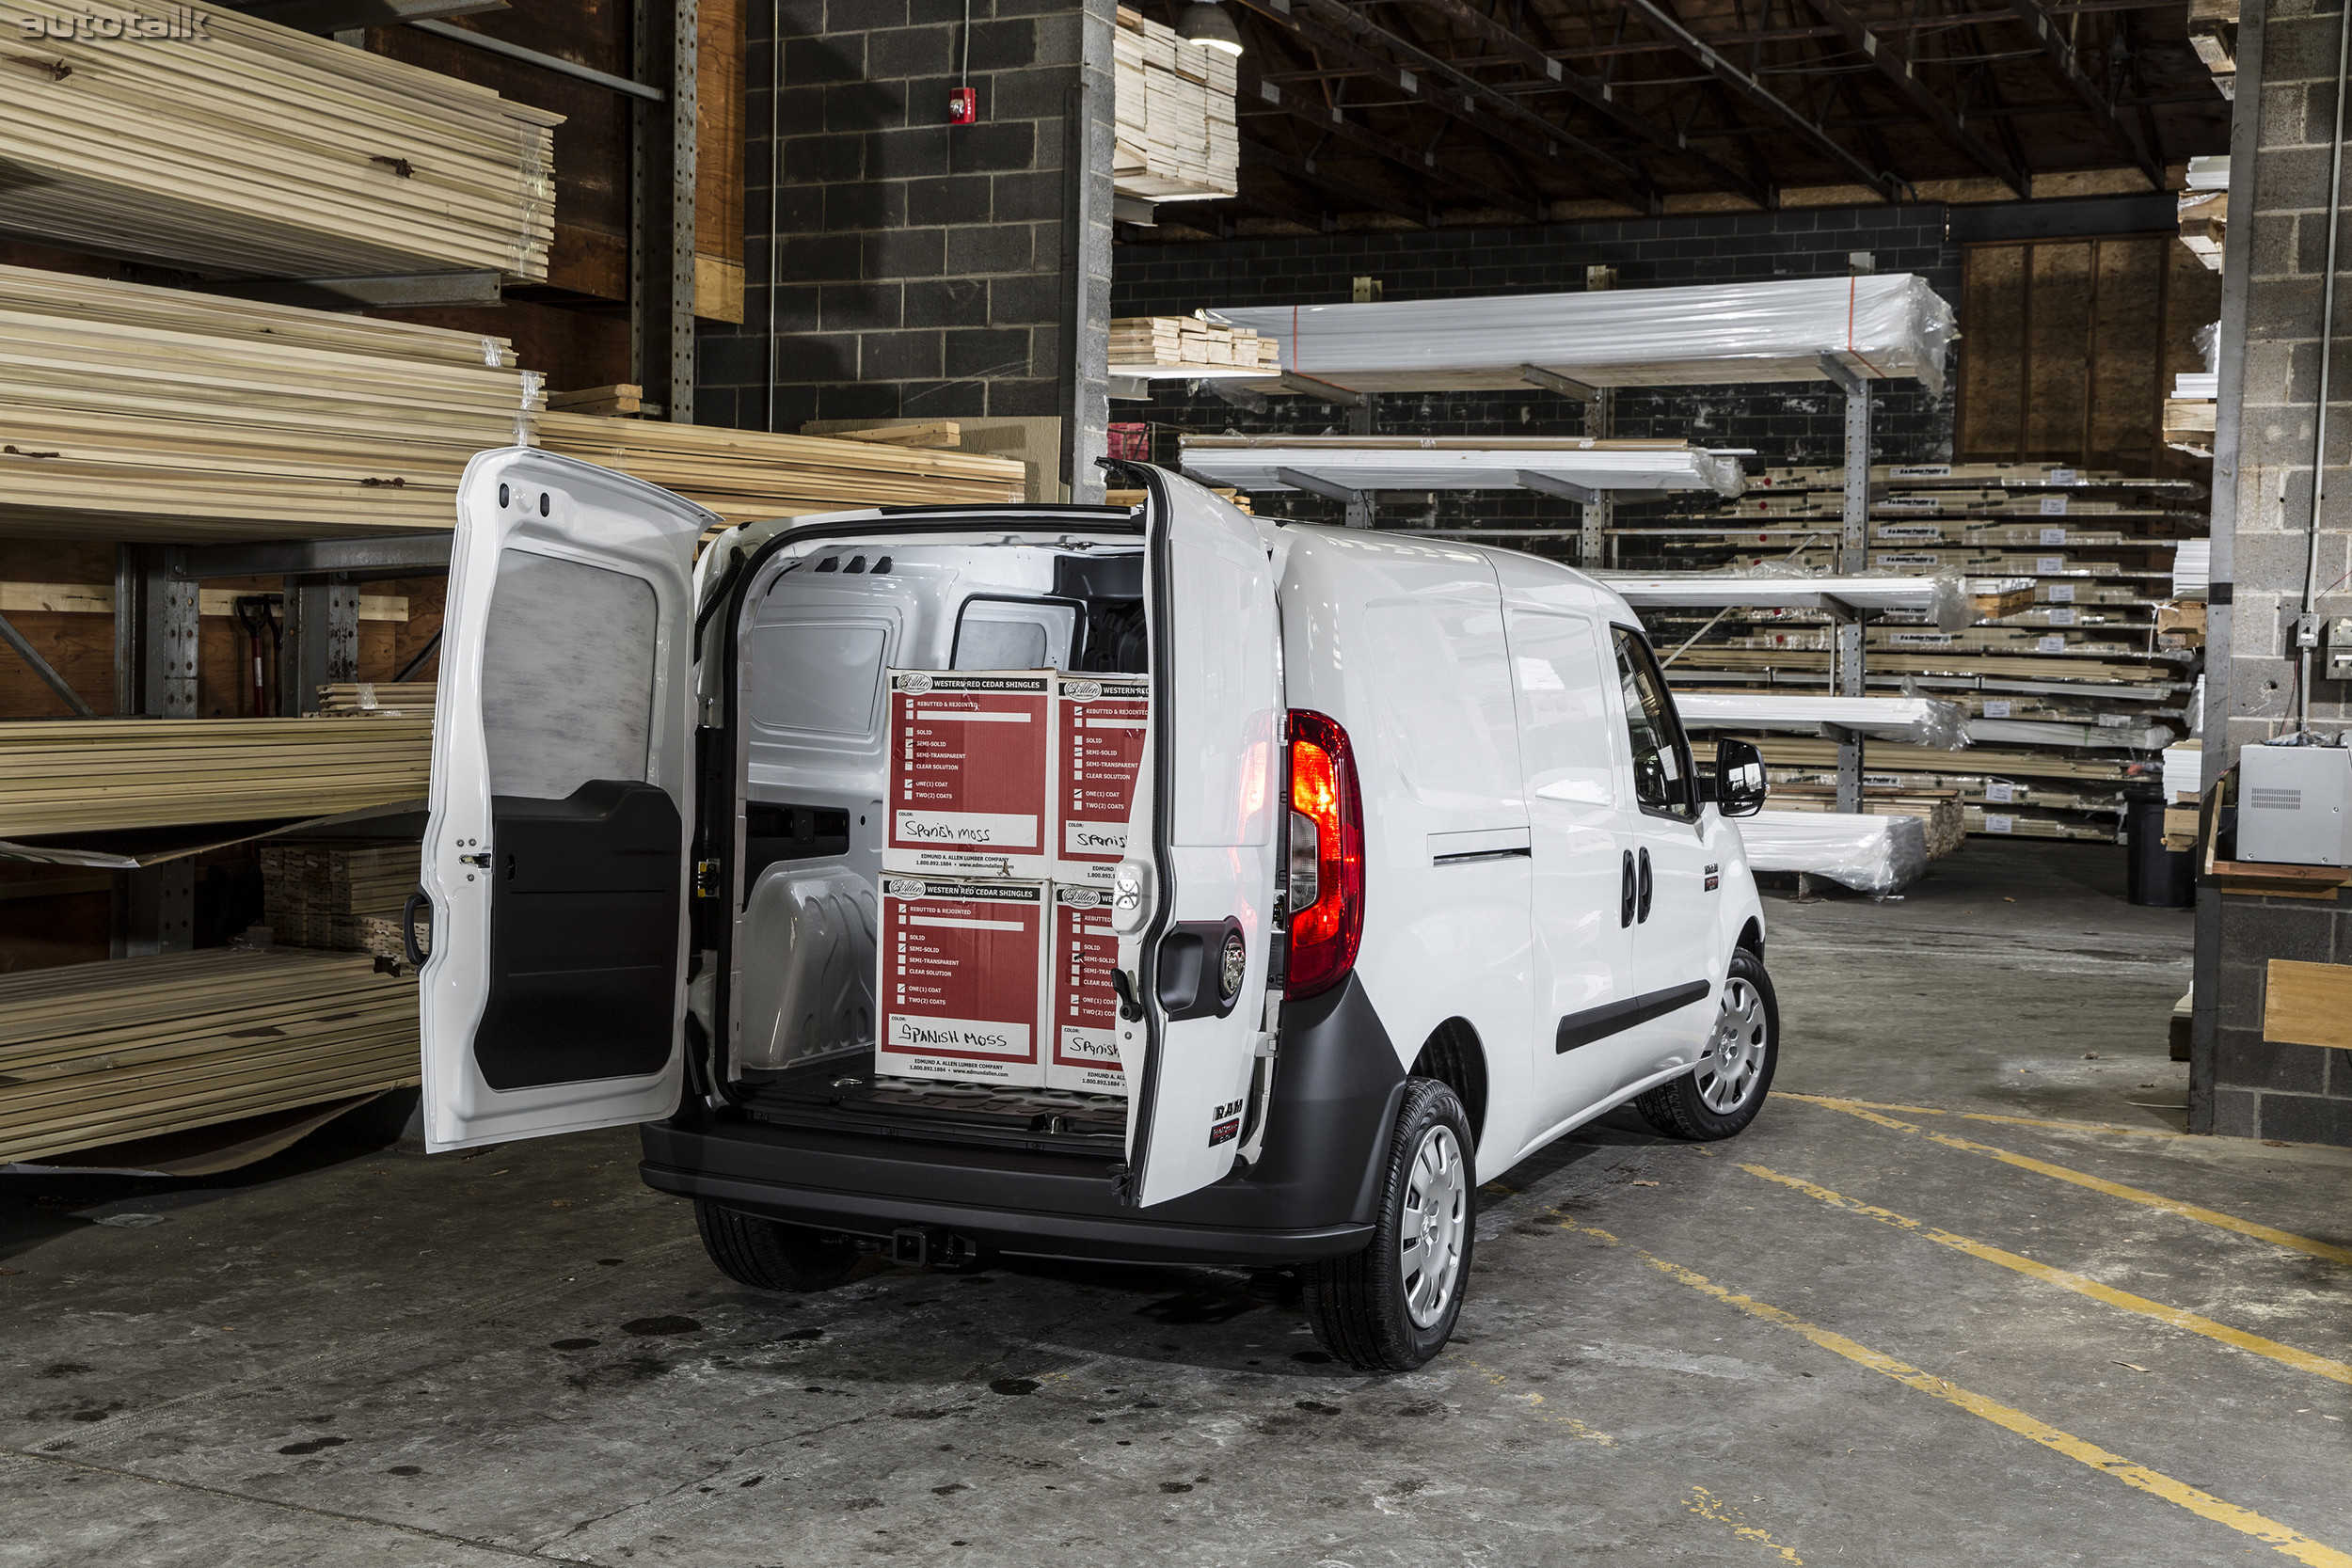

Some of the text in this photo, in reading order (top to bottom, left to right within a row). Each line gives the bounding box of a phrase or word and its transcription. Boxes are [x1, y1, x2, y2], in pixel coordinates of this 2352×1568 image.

[905, 820, 991, 843] Spanish moss
[1076, 832, 1128, 848] Spanis
[927, 886, 959, 895] WESTERN
[975, 888, 997, 896] CEDAR
[999, 889, 1033, 898] SHINGLES
[1084, 914, 1112, 923] REBUTTED
[909, 945, 940, 954] SEMI-SOLID
[909, 957, 960, 966] SEMI-TRANSPARENT
[1083, 956, 1116, 964] SEMI-SOLID
[926, 969, 952, 977] SOLUTION
[908, 985, 928, 993] ONE(1)
[1082, 996, 1102, 1005] ONE(1)
[1082, 1008, 1104, 1017] TWO(2)
[963, 1032, 1008, 1047] MOSS
[953, 1069, 1009, 1077] www.edmundallen.com
[1213, 1099, 1243, 1121] RAM
